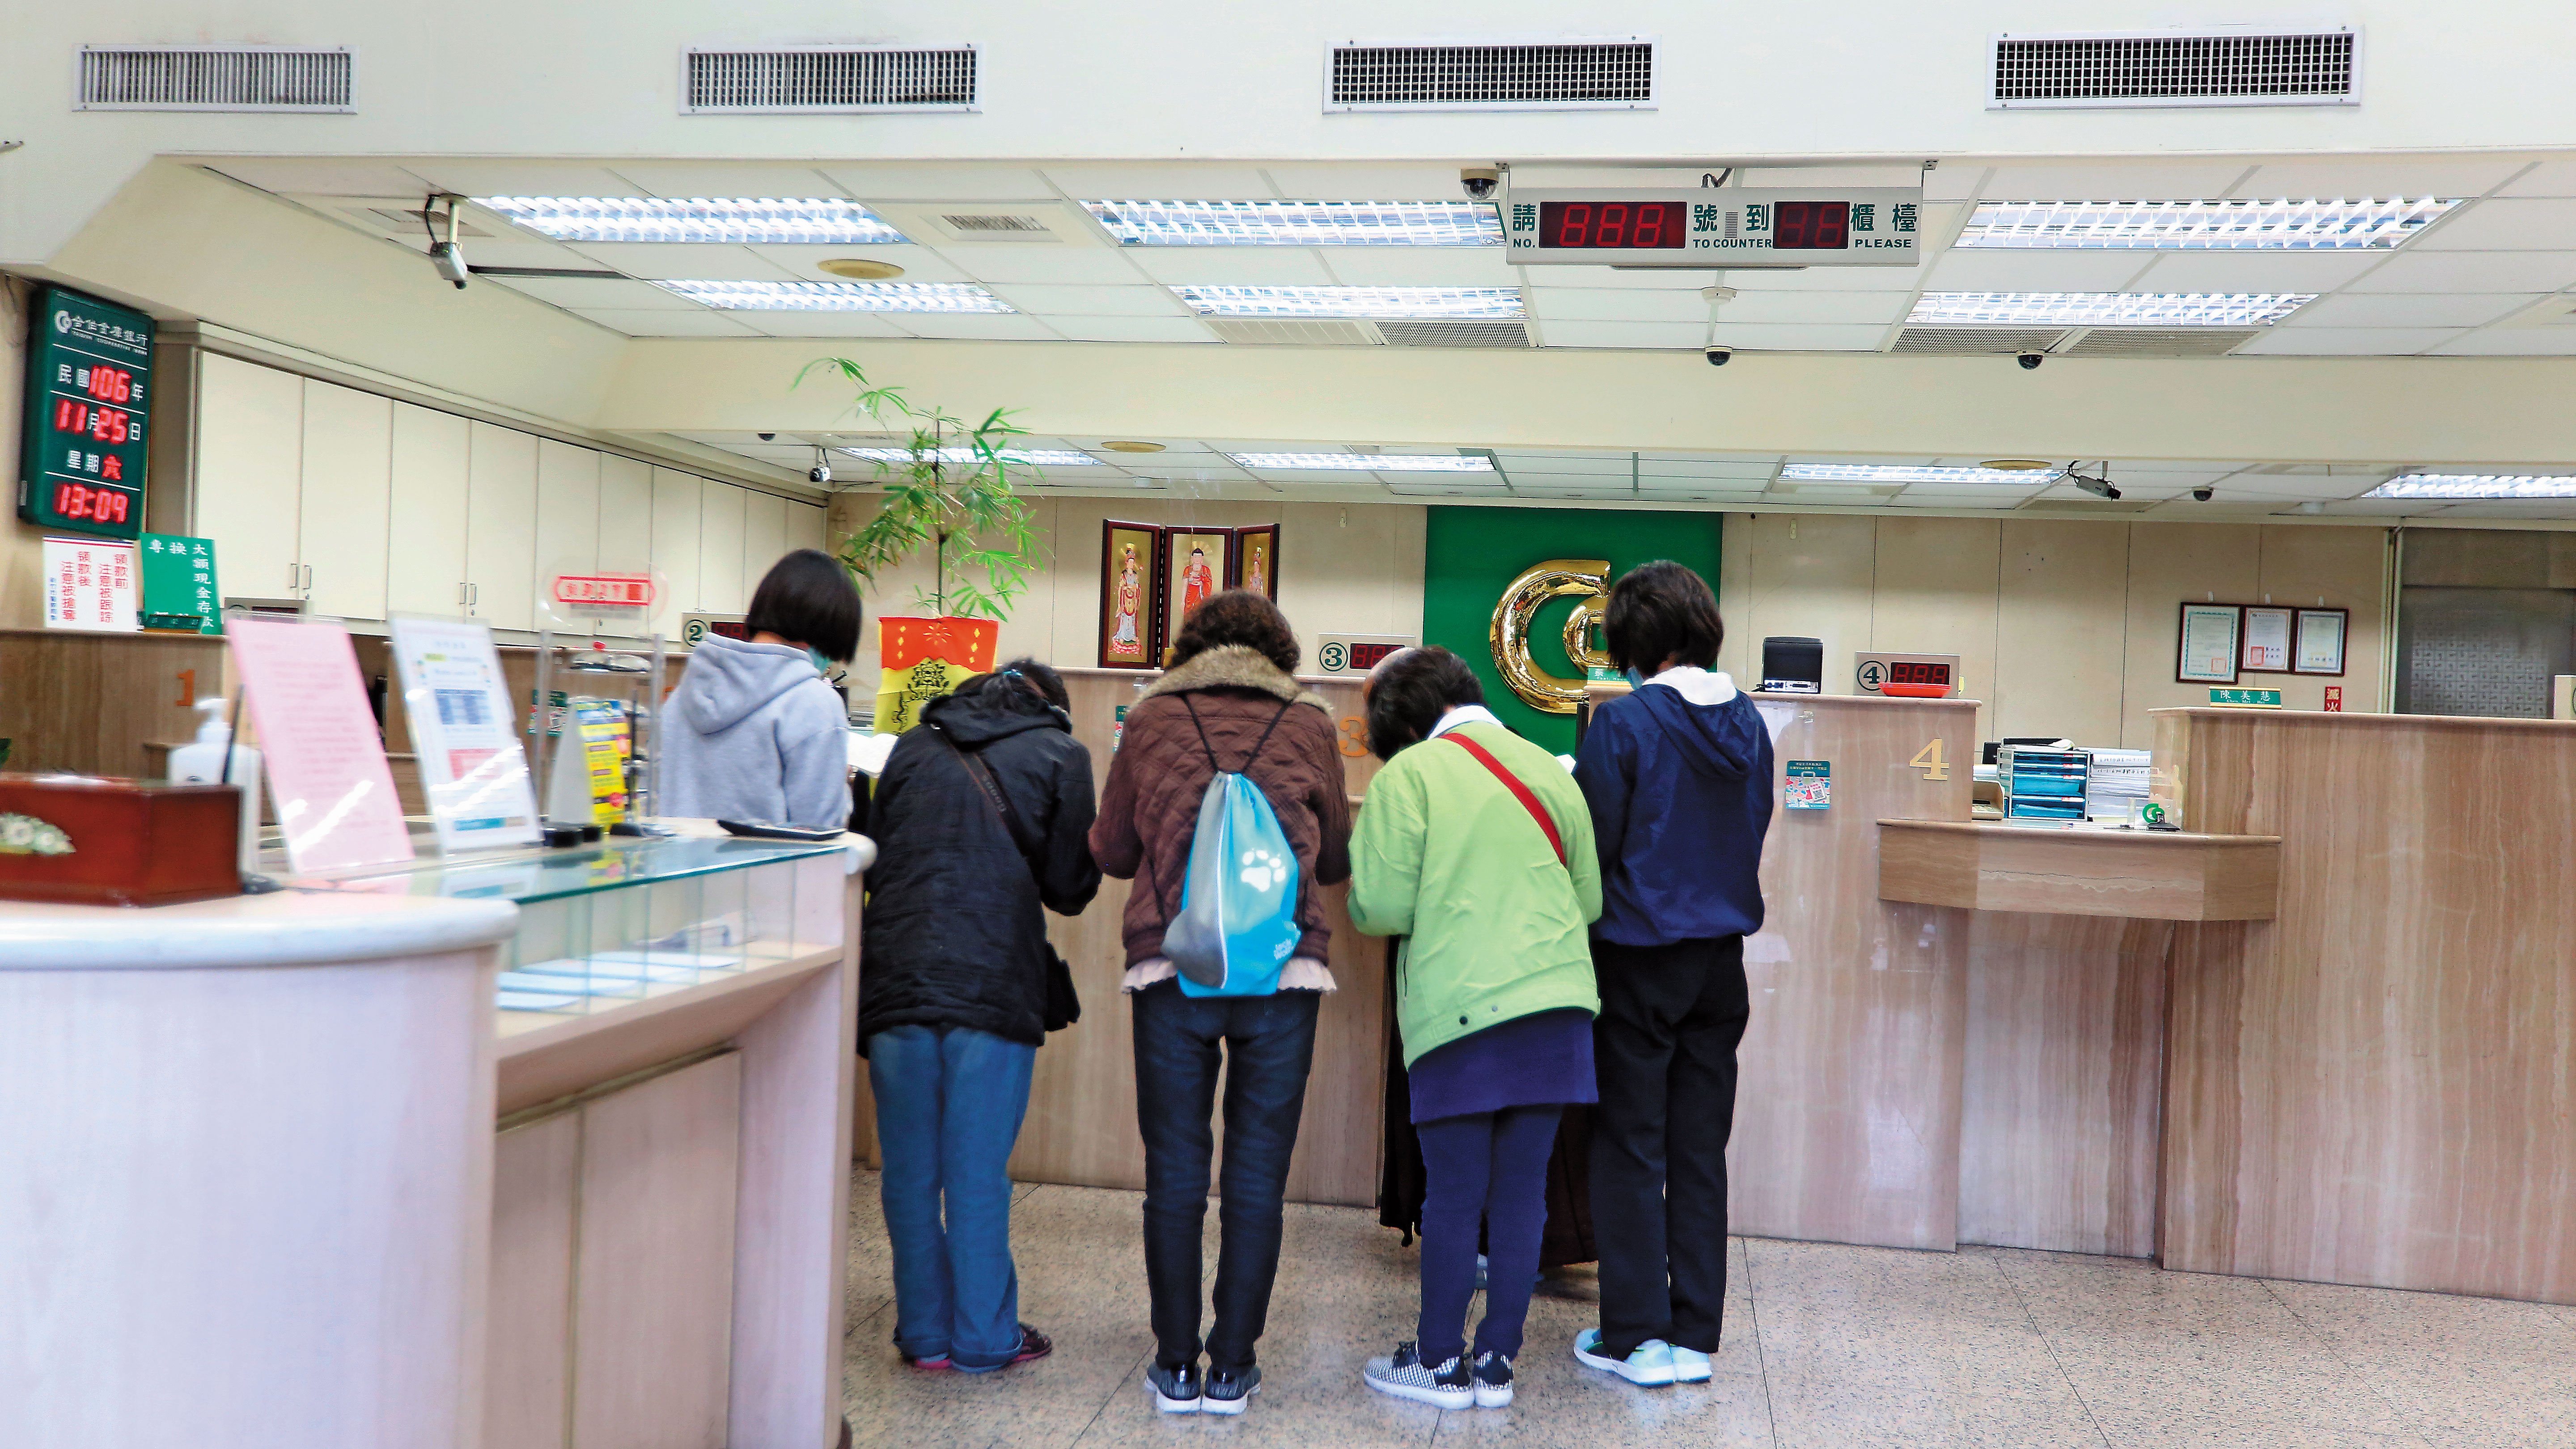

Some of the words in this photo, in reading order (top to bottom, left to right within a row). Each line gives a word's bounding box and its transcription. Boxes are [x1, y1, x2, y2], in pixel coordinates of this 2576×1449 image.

[1513, 204, 1536, 231] 請
[1851, 203, 1917, 232] 櫃檯
[1513, 239, 1535, 248] NO.
[1693, 238, 1710, 248] TO
[1713, 238, 1772, 248] COUNTER
[1855, 239, 1912, 249] PLEASE
[58, 485, 129, 524] 13:09
[1325, 647, 1342, 666] 3
[176, 669, 195, 707] 1
[1863, 666, 1880, 684] 4
[1338, 716, 1368, 757] 3
[1909, 738, 1949, 781] 4
